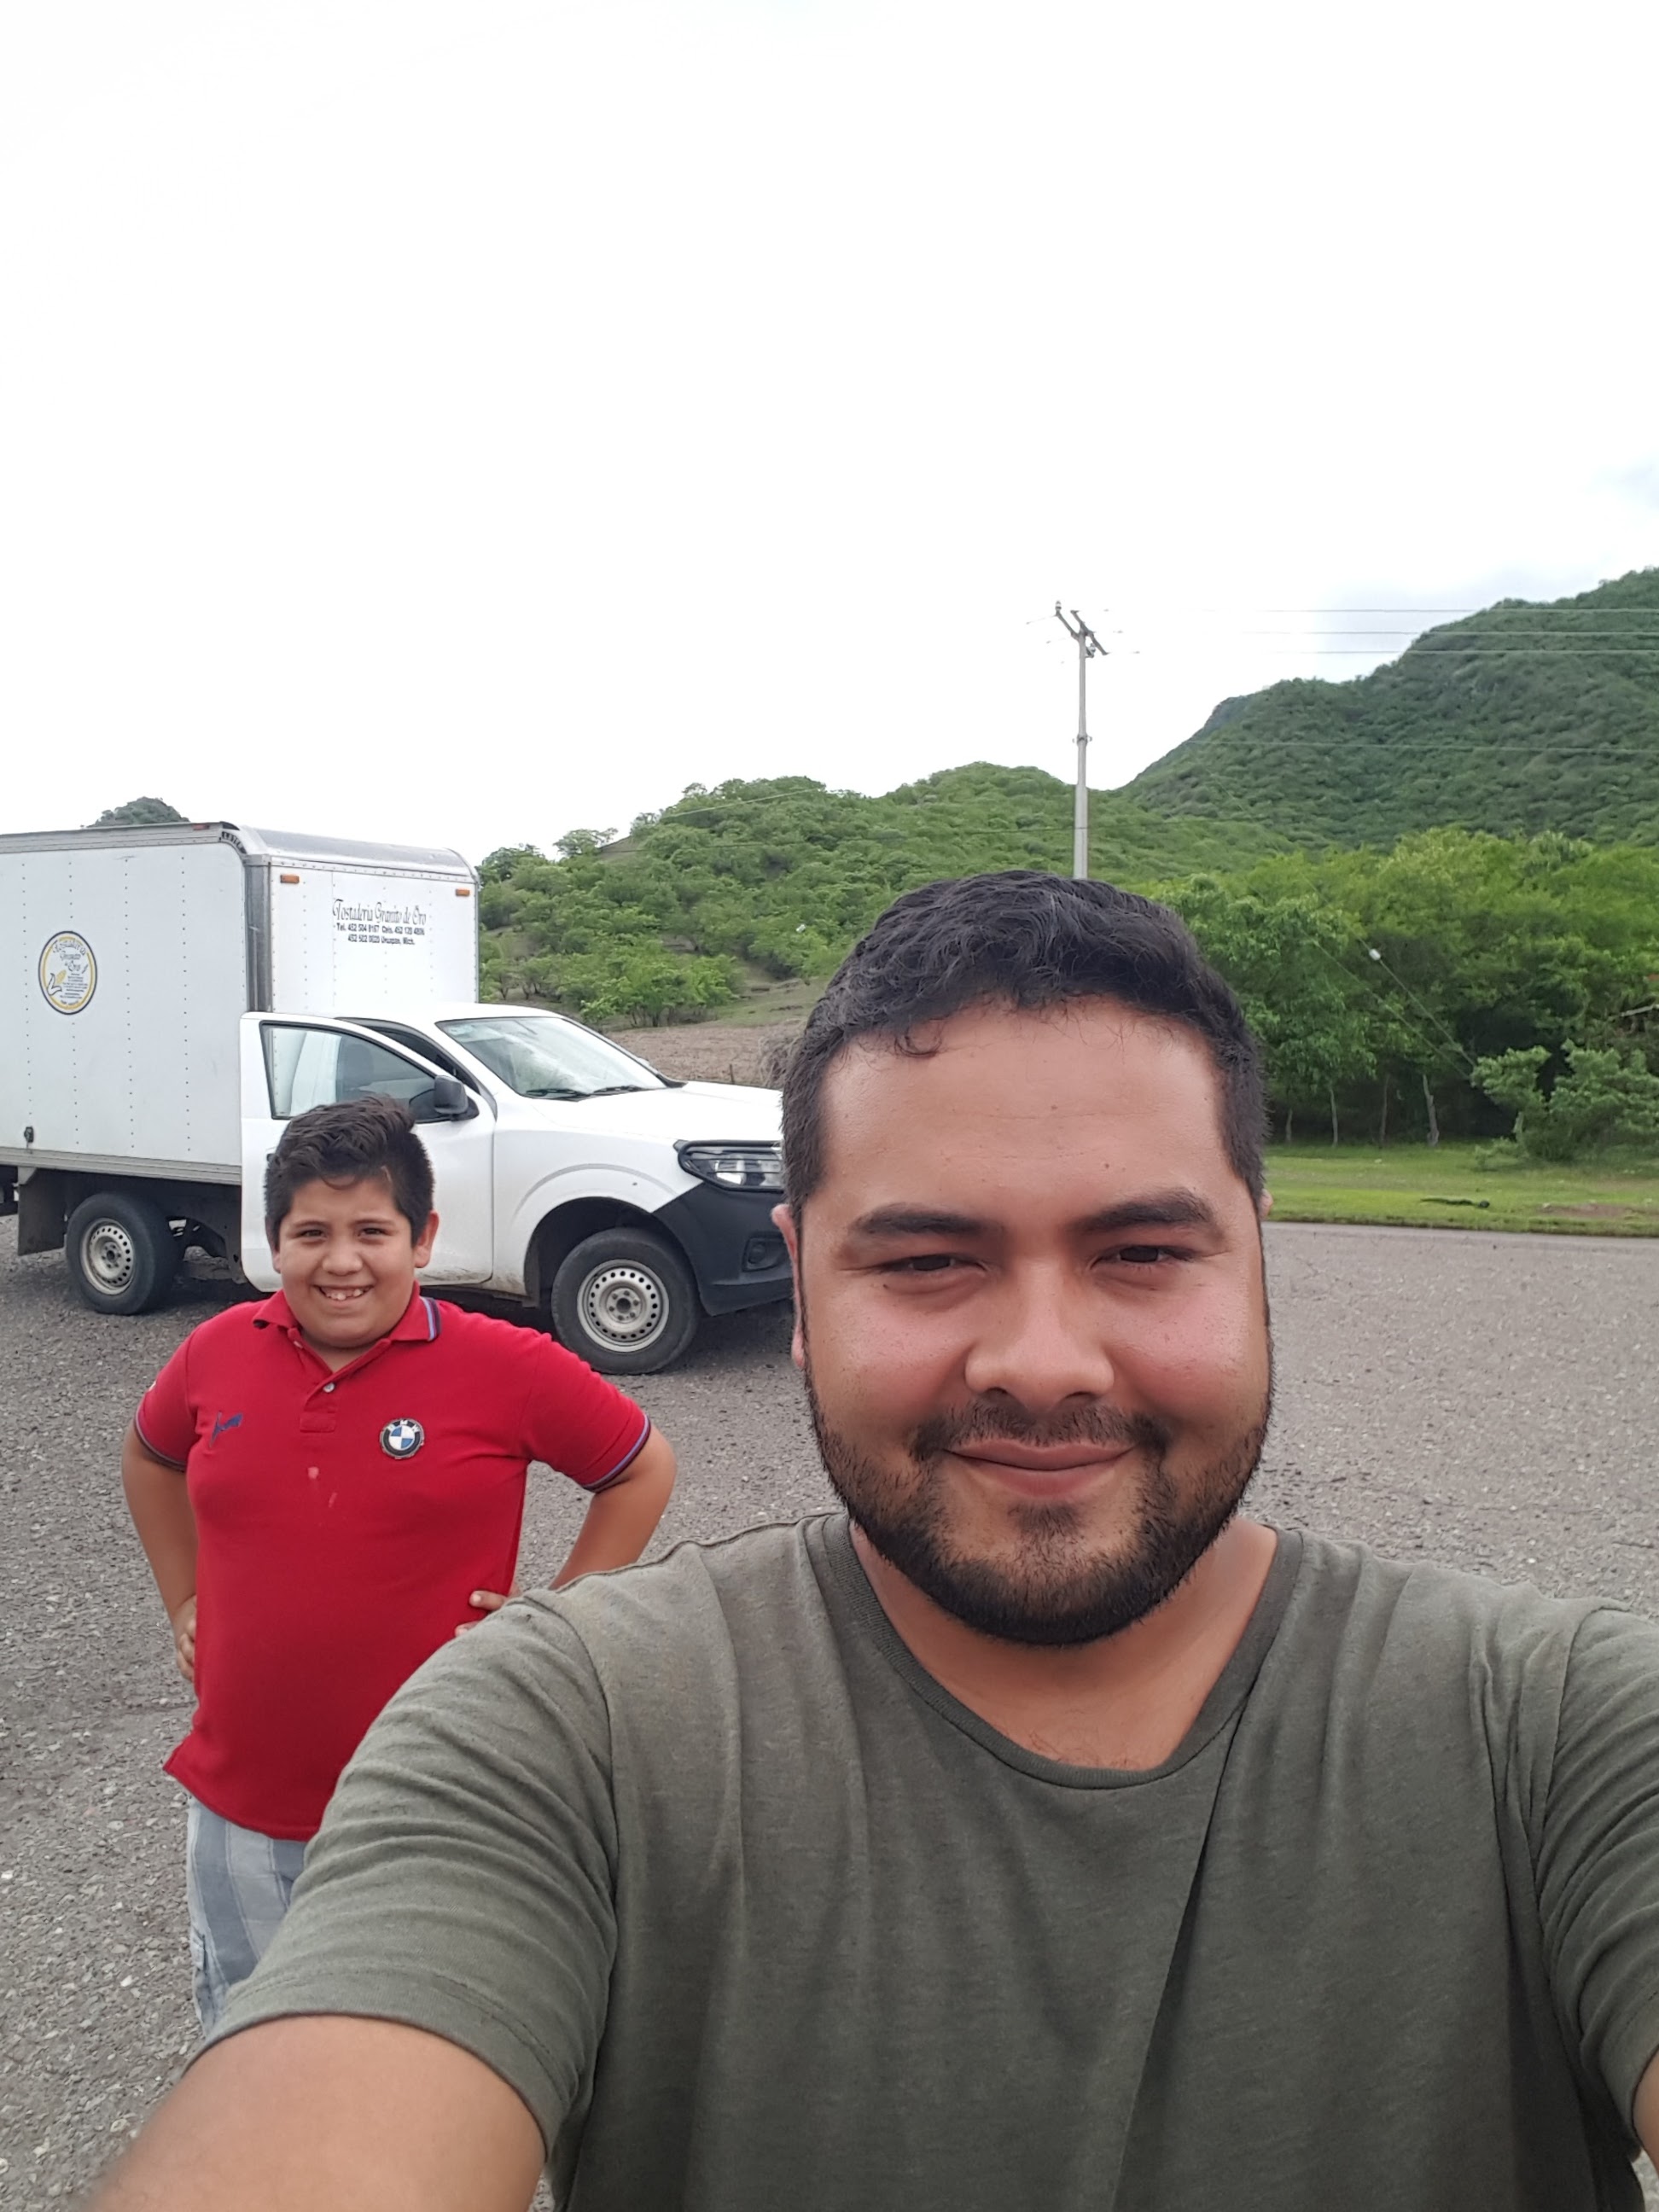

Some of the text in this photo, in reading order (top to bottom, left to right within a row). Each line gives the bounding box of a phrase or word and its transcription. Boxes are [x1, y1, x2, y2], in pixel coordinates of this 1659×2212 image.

[403, 906, 410, 924] de
[412, 905, 427, 926] Oro
[348, 923, 357, 932] 452
[386, 1419, 421, 1434] BMW
